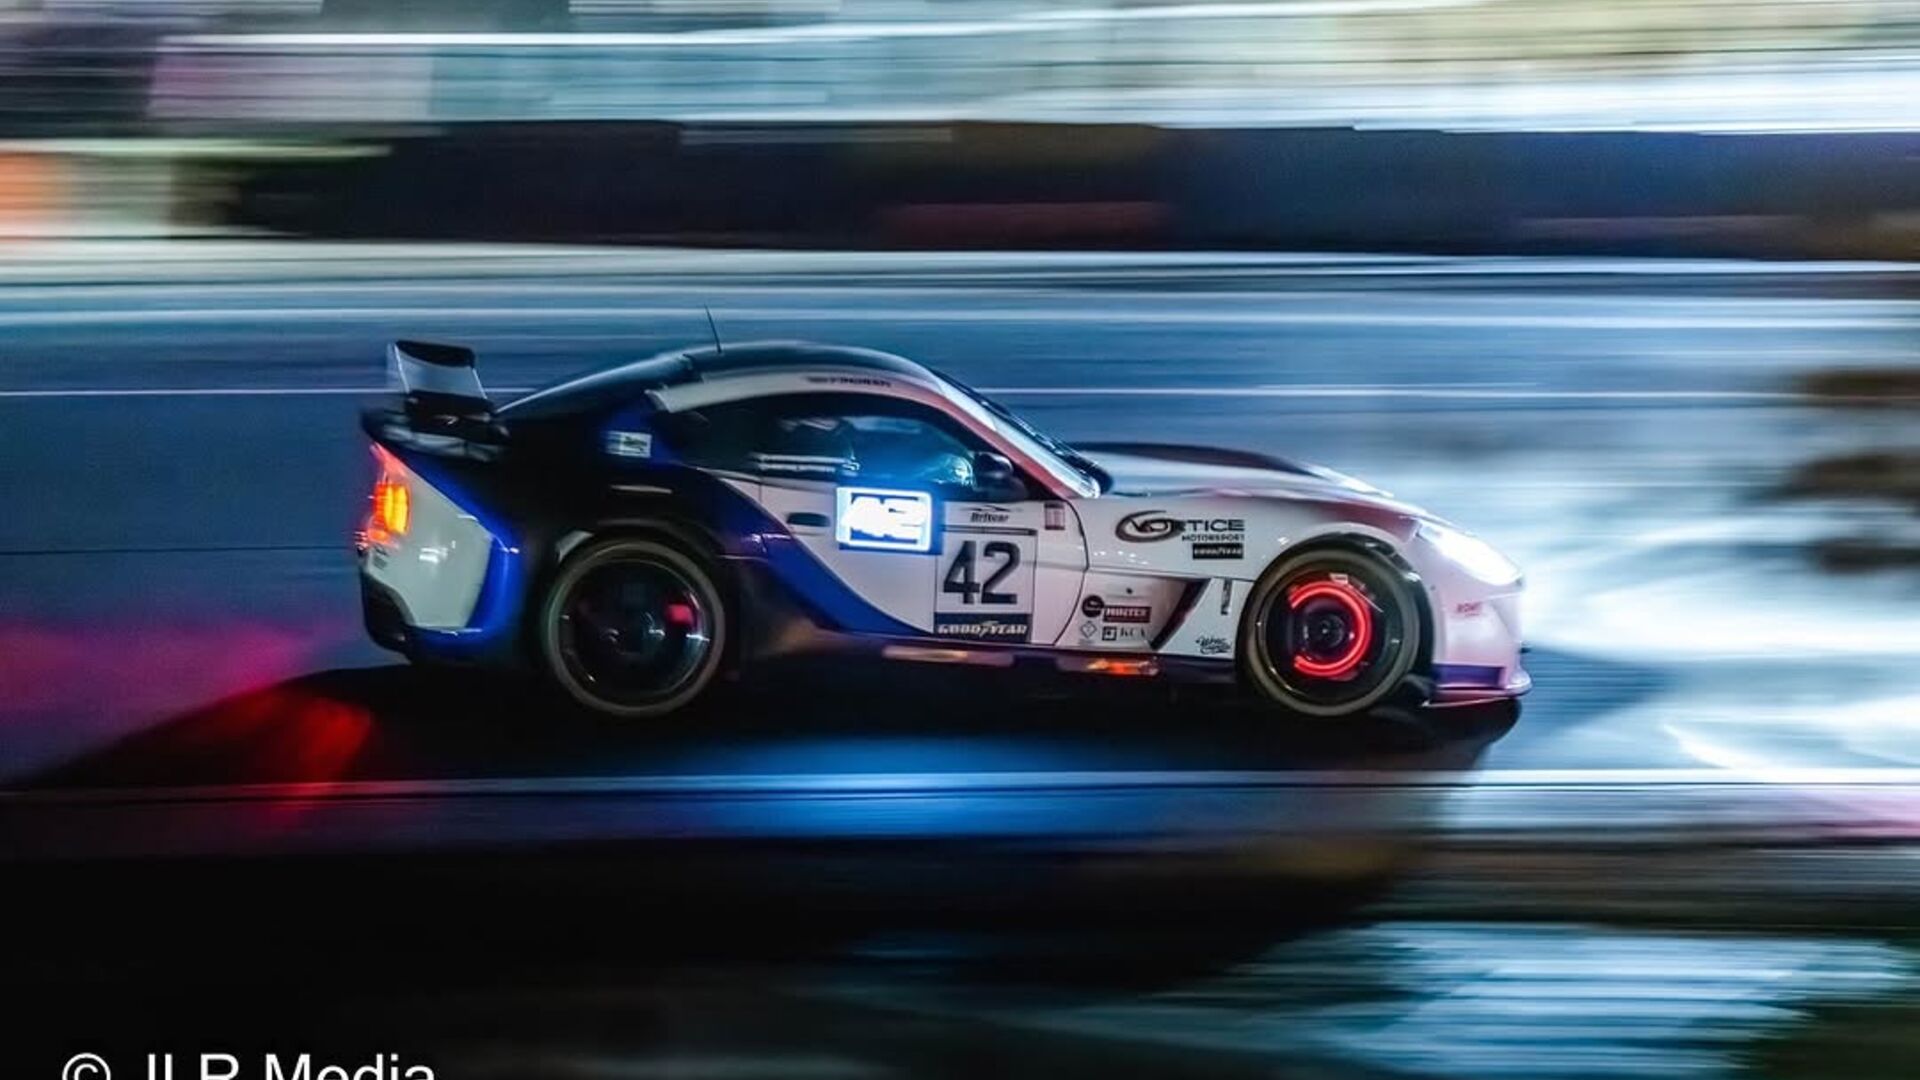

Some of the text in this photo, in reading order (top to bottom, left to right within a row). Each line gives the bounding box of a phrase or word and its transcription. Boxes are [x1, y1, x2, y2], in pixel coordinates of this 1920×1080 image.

[842, 496, 928, 539] 42
[943, 540, 1021, 605] 42
[937, 621, 1028, 637] GOODYEAR
